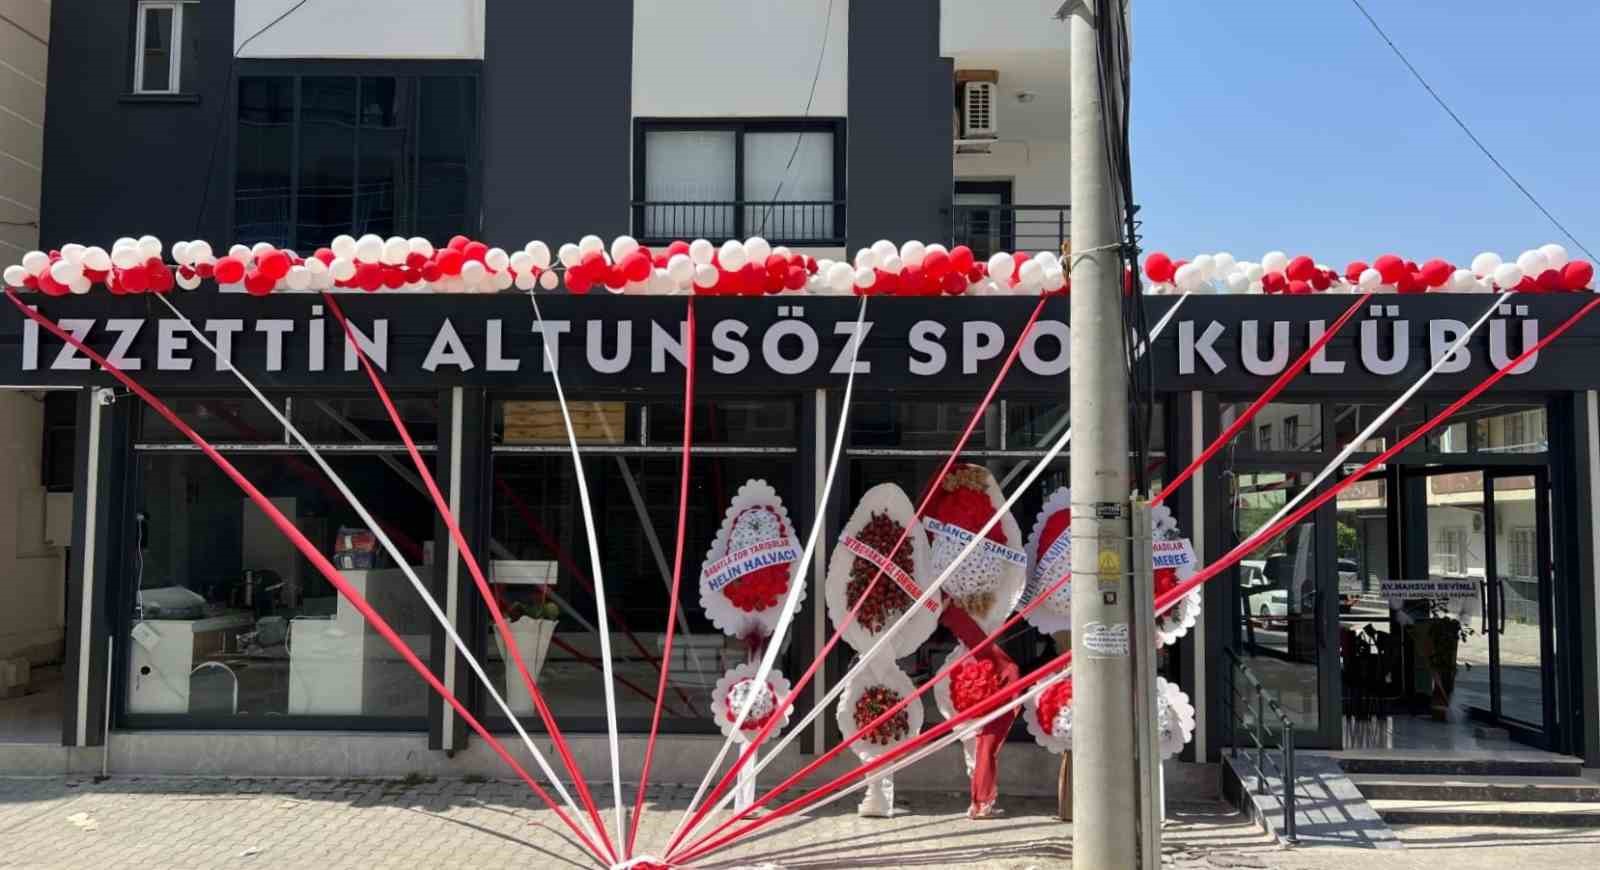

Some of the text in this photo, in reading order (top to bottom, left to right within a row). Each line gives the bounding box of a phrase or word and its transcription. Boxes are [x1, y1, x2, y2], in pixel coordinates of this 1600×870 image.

[22, 304, 1540, 376] İZZETTİN ALTUNSÖZ SPO KULÜBÜ
[708, 549, 798, 591] HELİN HALVACI
